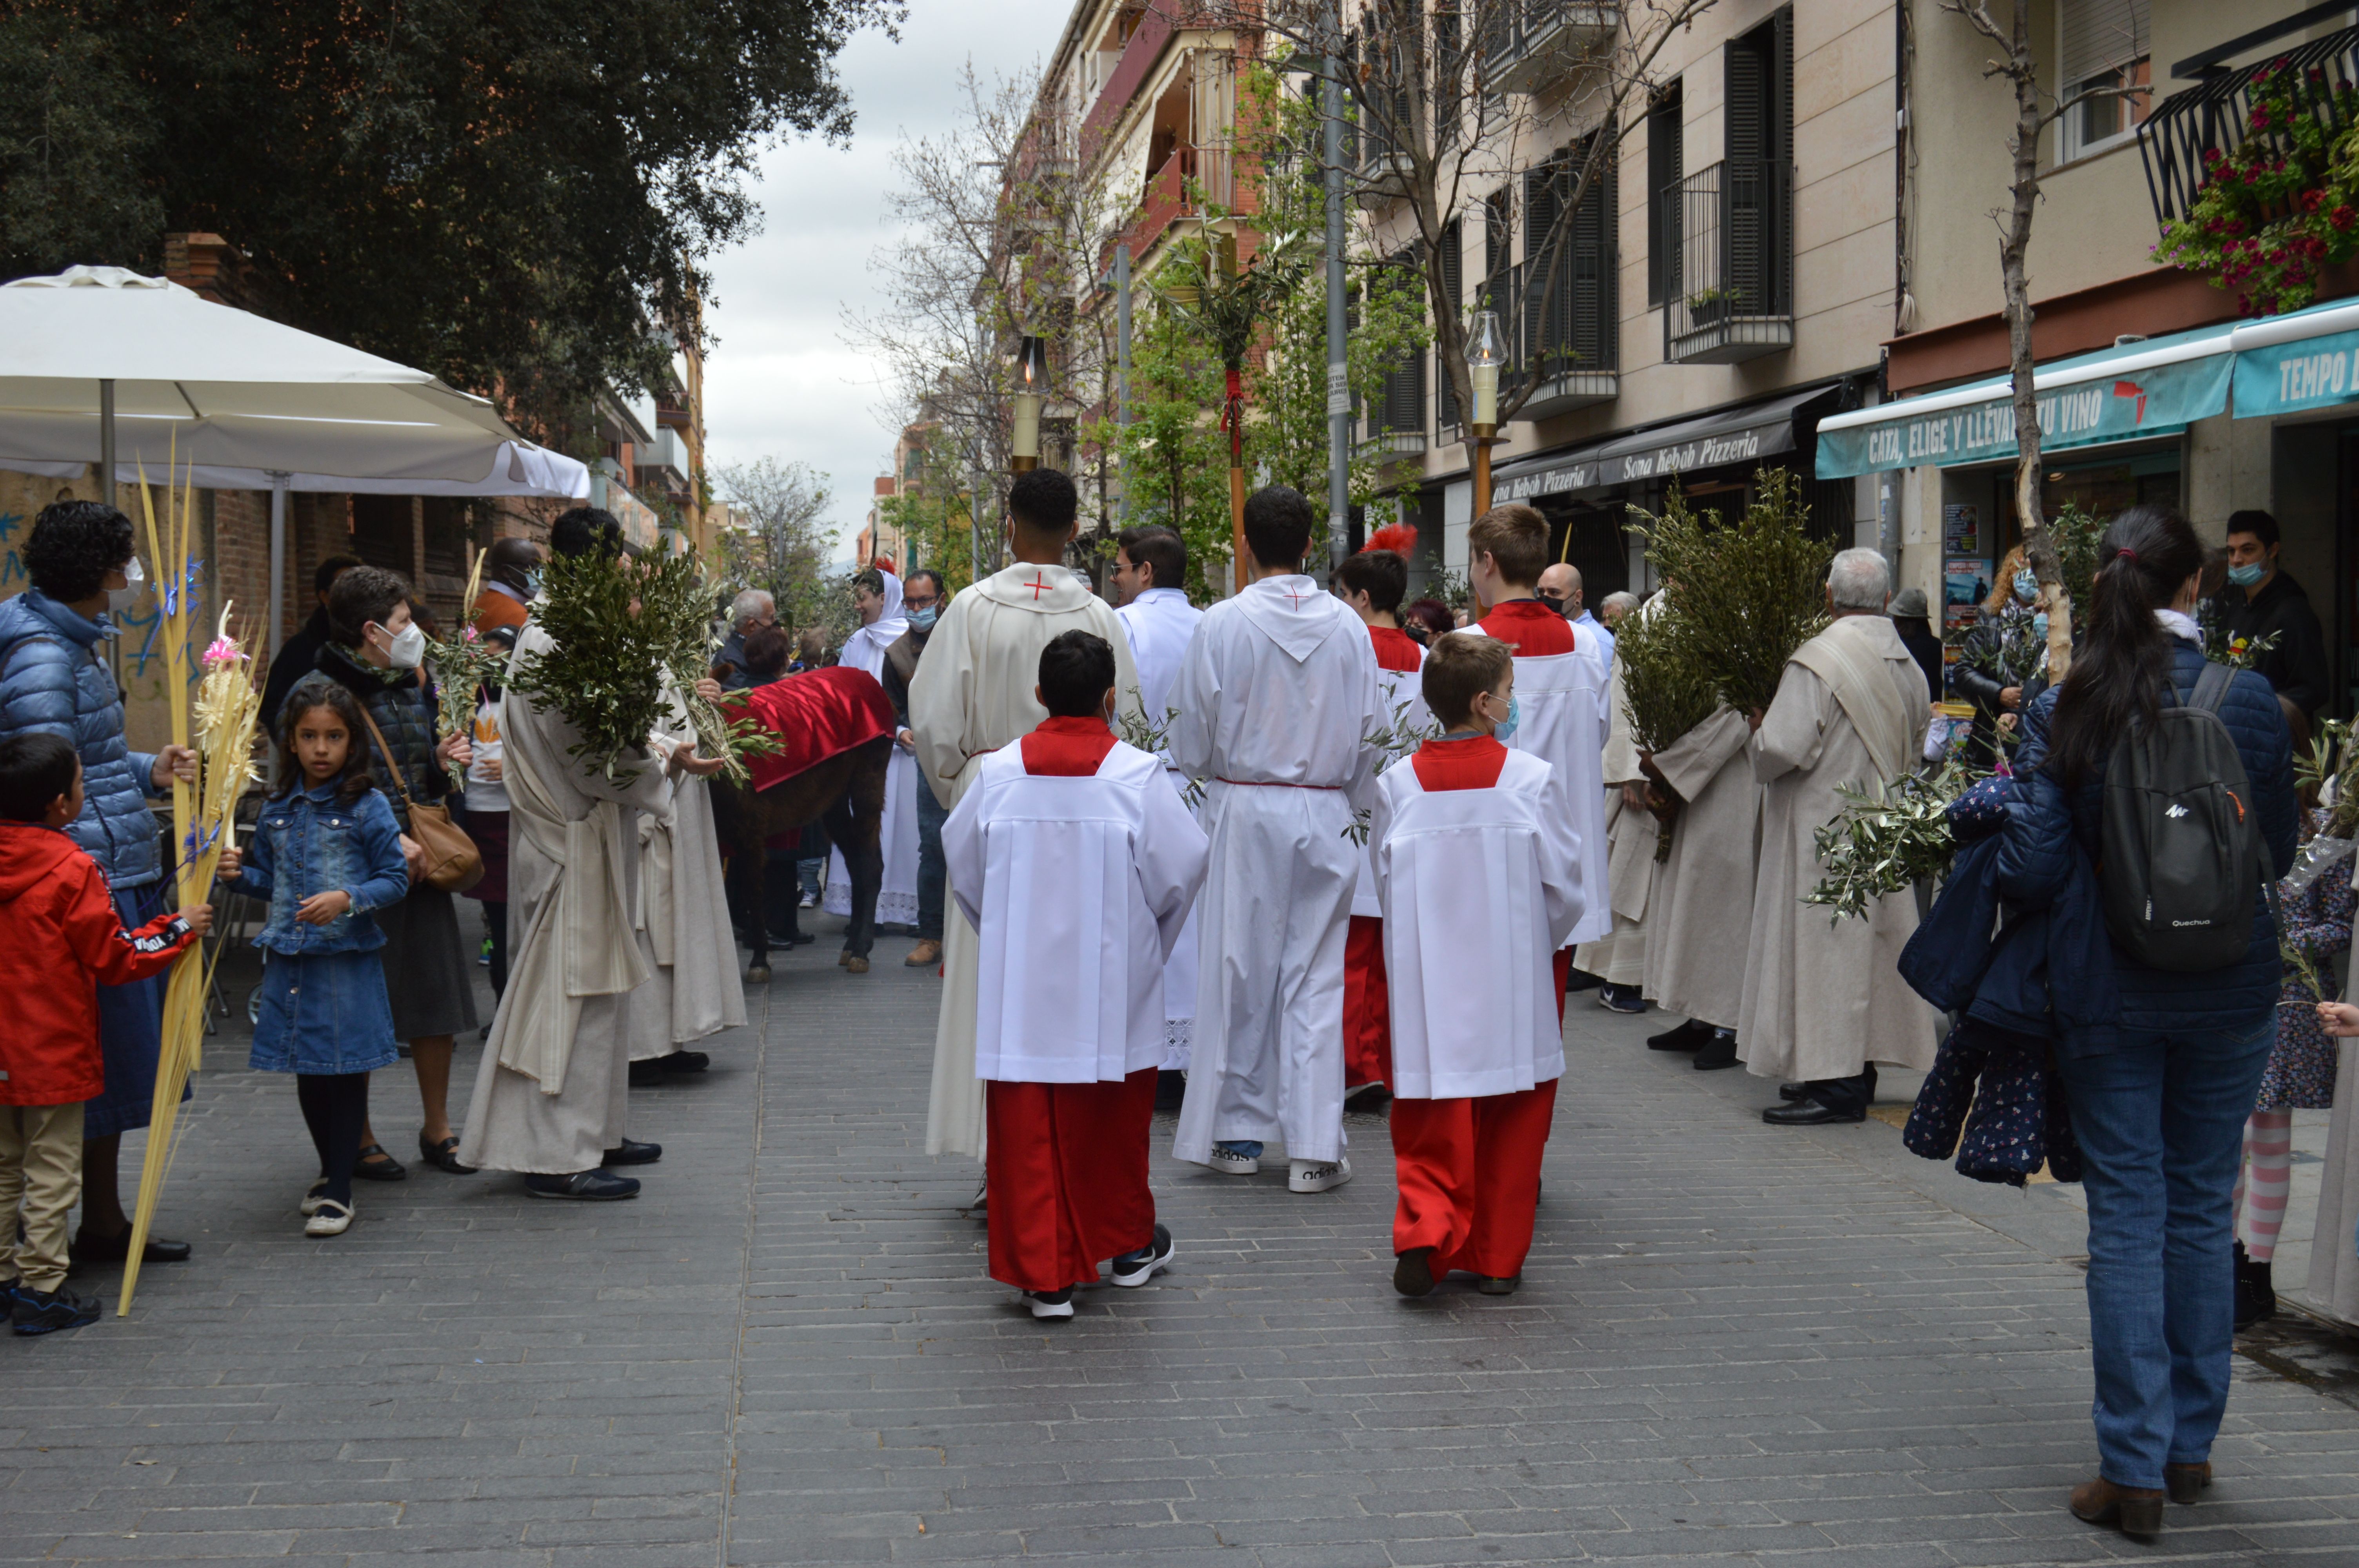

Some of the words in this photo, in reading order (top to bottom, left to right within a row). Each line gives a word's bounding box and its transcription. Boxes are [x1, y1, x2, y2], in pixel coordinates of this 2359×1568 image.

[2279, 351, 2346, 401] TEMPO
[1869, 427, 1904, 465] CATA,
[1908, 418, 1948, 458] ELIGE
[1954, 416, 1963, 450] Y
[1967, 403, 2016, 448] LLÉVAT
[2035, 397, 2056, 436] TU
[2061, 390, 2102, 433] VINO
[1624, 456, 1652, 479] Sona
[1656, 443, 1696, 473] Kebab
[1700, 430, 1758, 465] Pizzeria
[1493, 486, 1510, 502] ona
[1513, 474, 1540, 499] Kebab
[1544, 466, 1585, 493] Pizzeria
